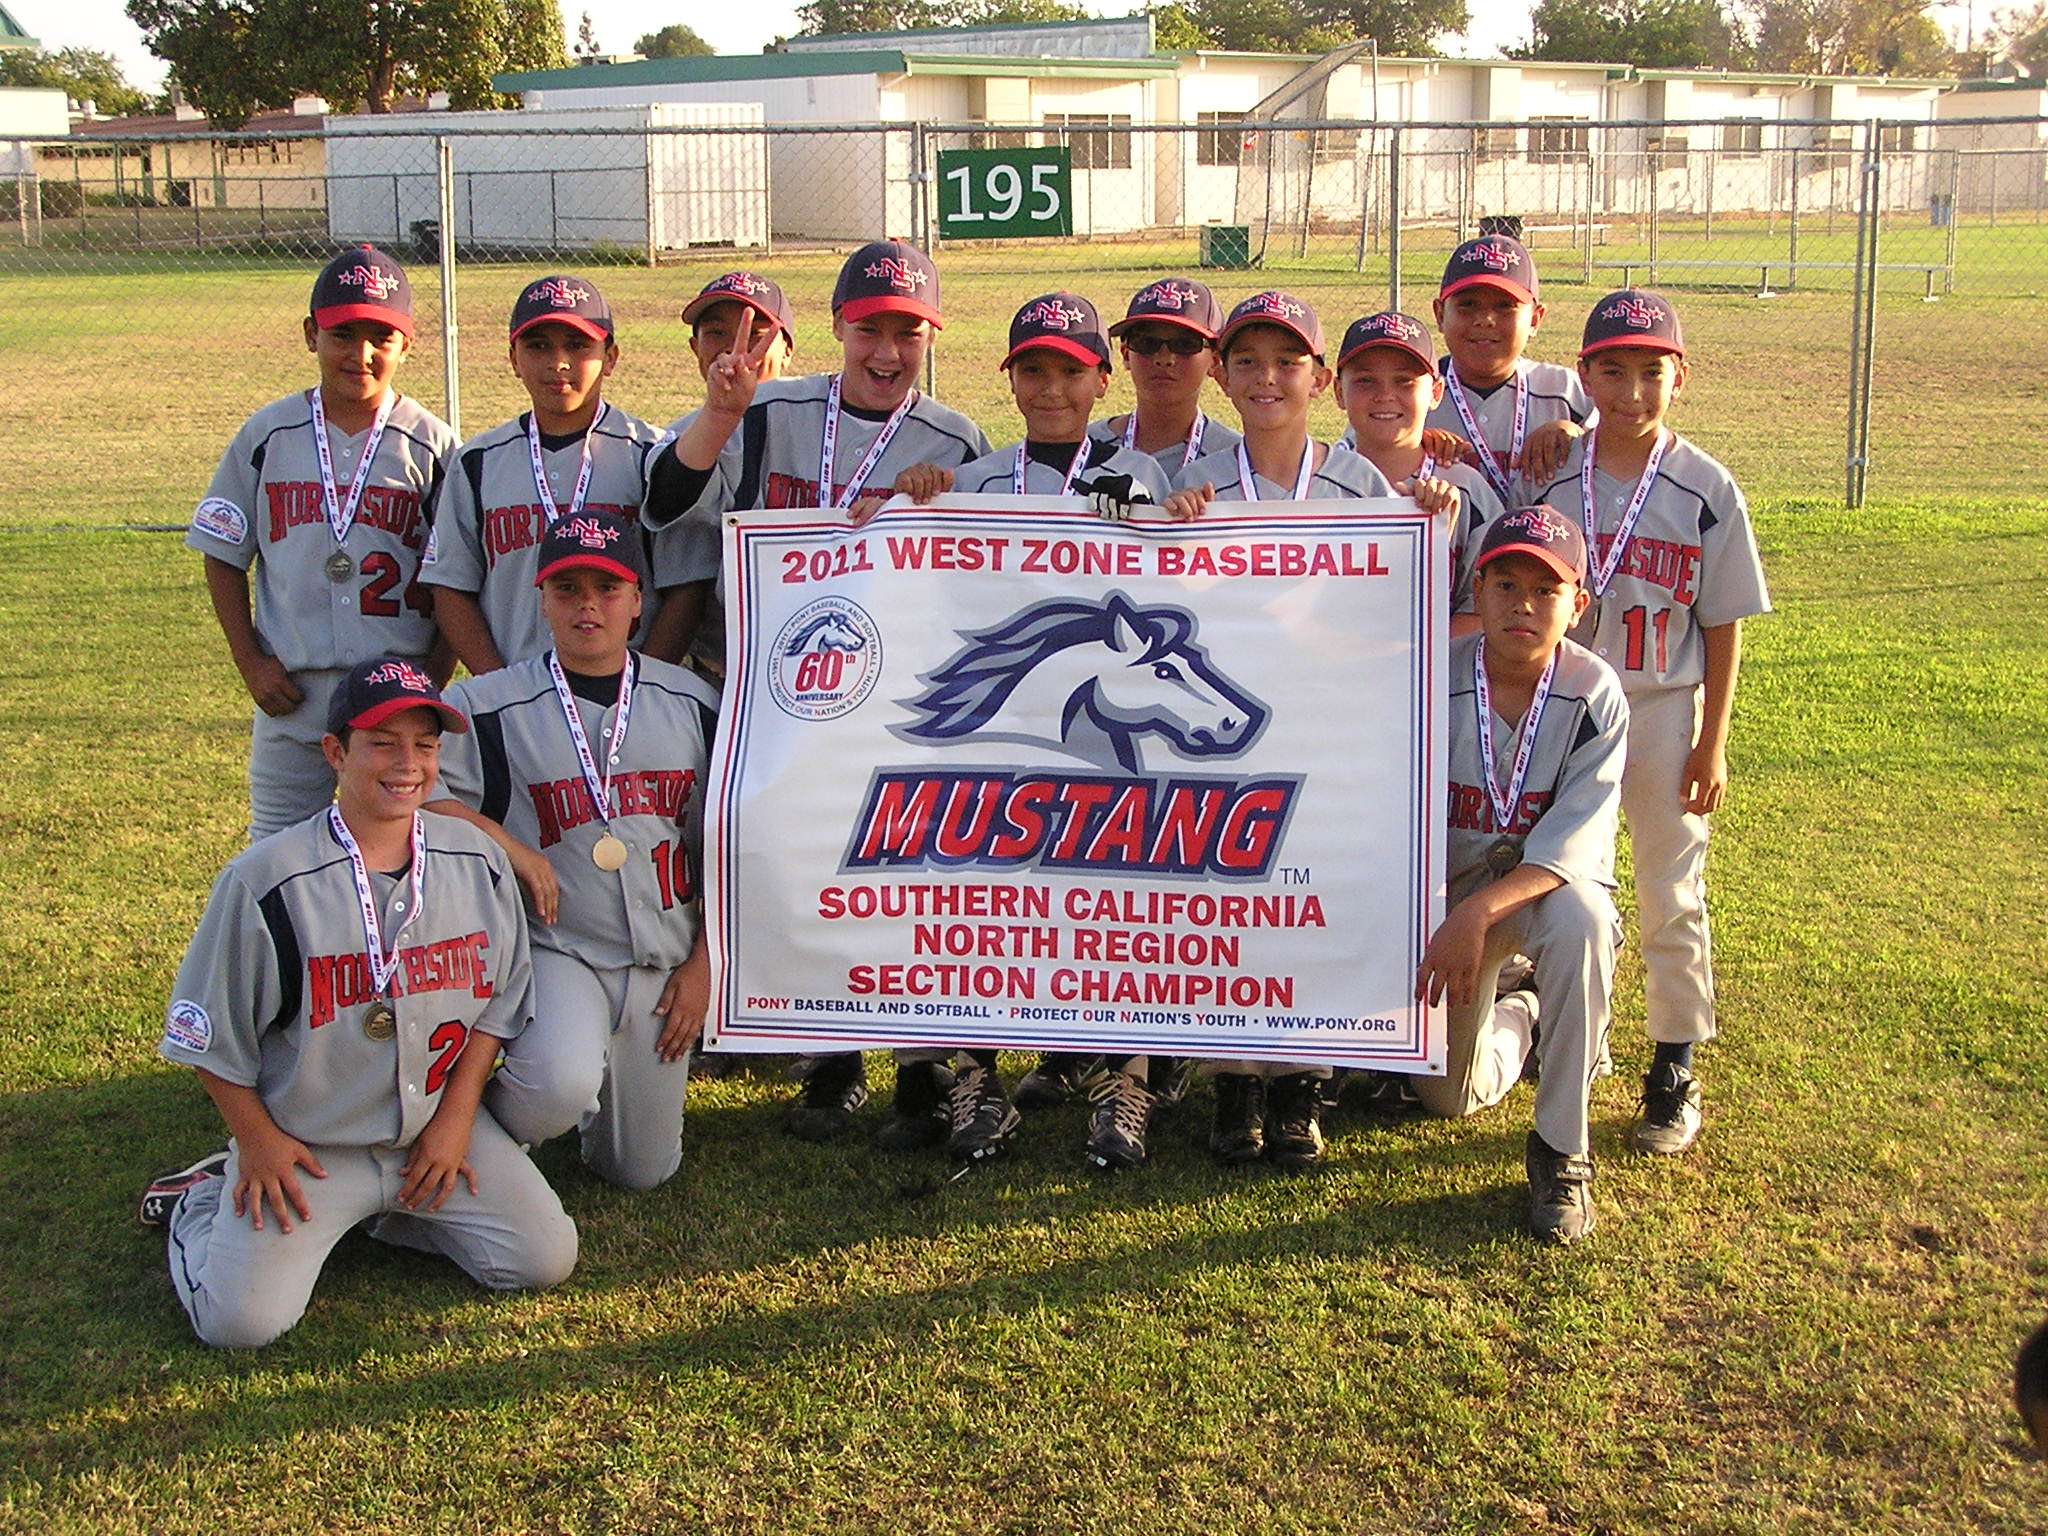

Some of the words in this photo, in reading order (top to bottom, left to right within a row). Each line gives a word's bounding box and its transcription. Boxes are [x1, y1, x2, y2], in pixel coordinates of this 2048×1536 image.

[947, 164, 1060, 221] 195
[879, 257, 916, 292] NS
[1616, 298, 1652, 328] NS
[781, 539, 874, 584] 2011
[886, 537, 1009, 571] WEST
[1020, 540, 1143, 576] ZONE
[1158, 543, 1389, 577] BASEBALL
[848, 607, 864, 622] AND
[862, 622, 878, 667] SOFTBALL
[1622, 605, 1670, 673] 11
[795, 692, 844, 702] ANNIVERSARY
[857, 779, 1286, 869] MUSTANG
[1279, 868, 1310, 885] TM
[818, 884, 1050, 920] SOUTHERN
[1064, 888, 1326, 928] CALIFORNIA
[914, 924, 1058, 959] NORTH
[1073, 928, 1240, 967] REGION
[847, 964, 1035, 999] SECTION
[1050, 968, 1294, 1008] CHAMPION
[747, 997, 790, 1010] PONY
[794, 999, 872, 1014] BASEBALL
[877, 1001, 910, 1015] AND
[914, 1003, 990, 1018] SOFTBALL
[1010, 1007, 1078, 1021] PROTECT
[1083, 1009, 1116, 1022] OUR
[1120, 1011, 1192, 1025] NATION'S
[1196, 1013, 1247, 1027] YOUTH
[1266, 1015, 1396, 1031] WWW.PONY.ORG
